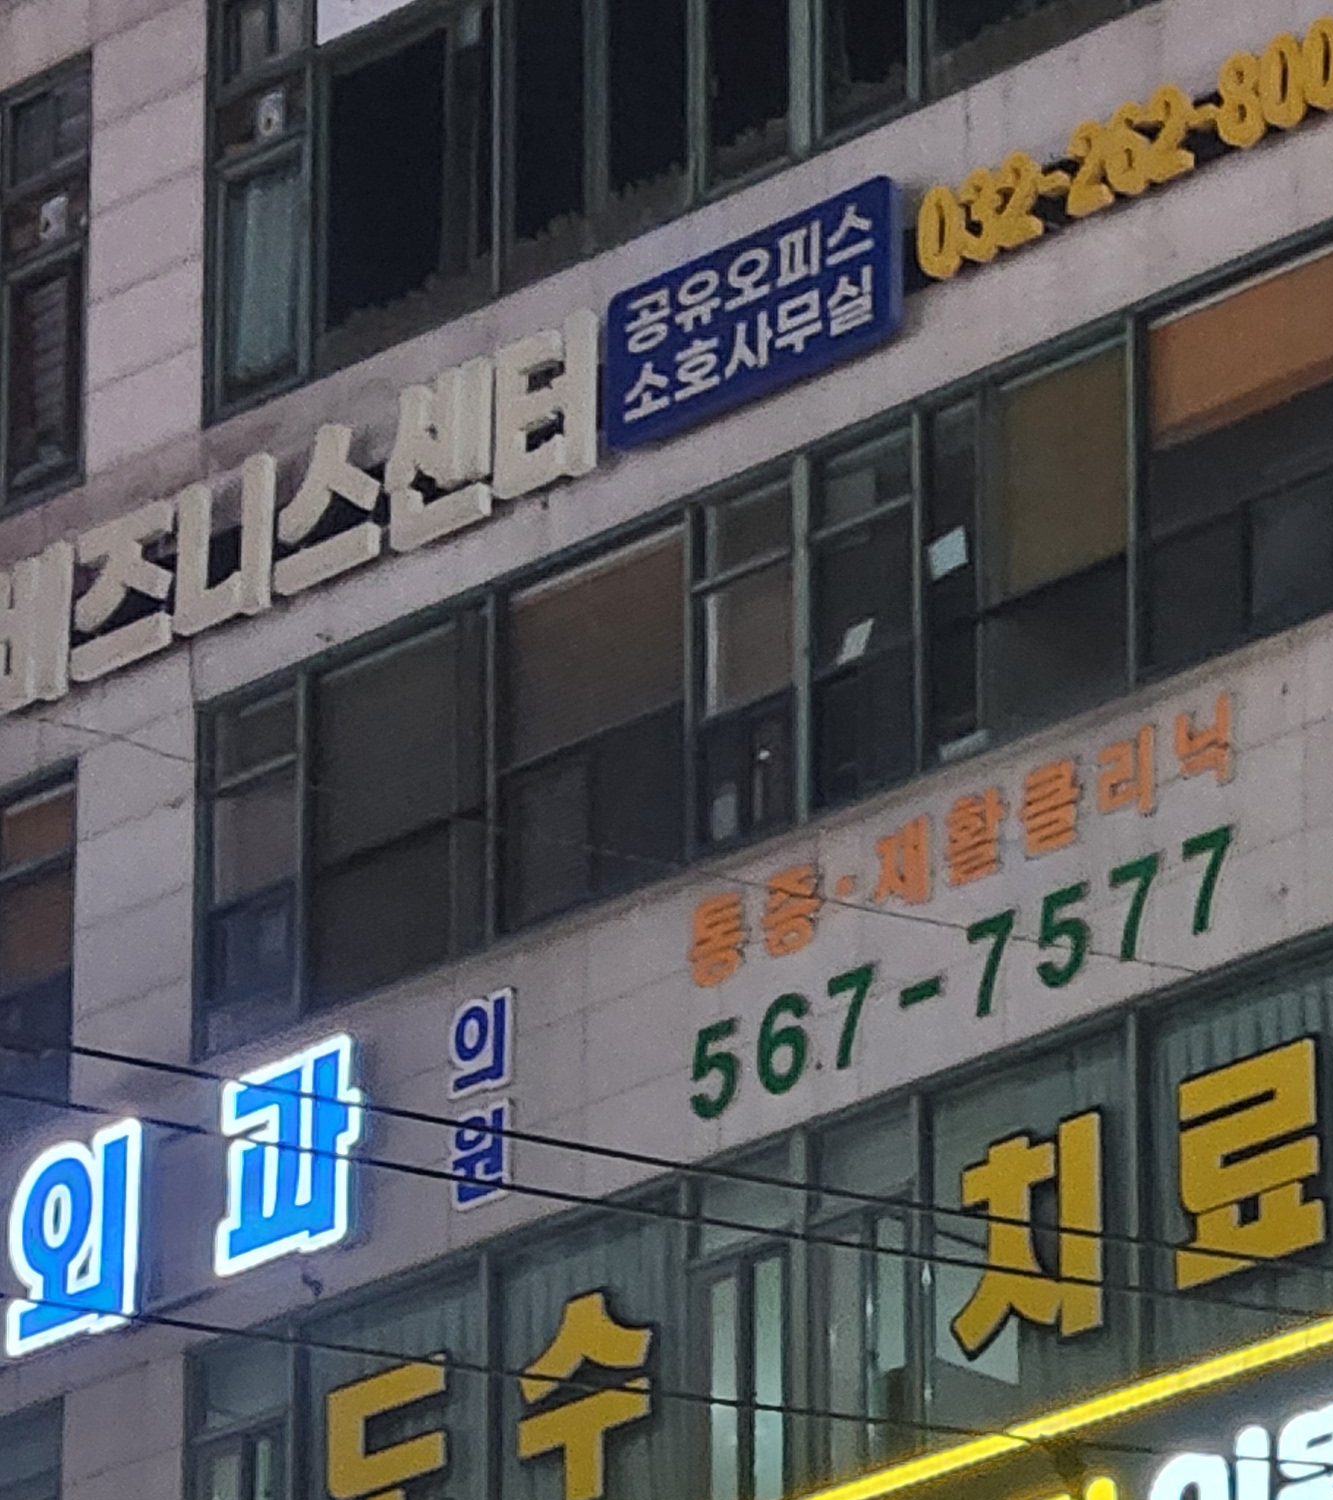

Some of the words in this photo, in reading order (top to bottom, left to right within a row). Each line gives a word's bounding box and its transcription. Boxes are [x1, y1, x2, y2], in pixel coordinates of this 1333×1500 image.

[624, 265, 876, 424] 소호사무실
[625, 205, 873, 354] 공유오피스
[689, 823, 1232, 1119] 567-7577
[451, 986, 517, 1212] 의원
[950, 1036, 1328, 1358] 치료
